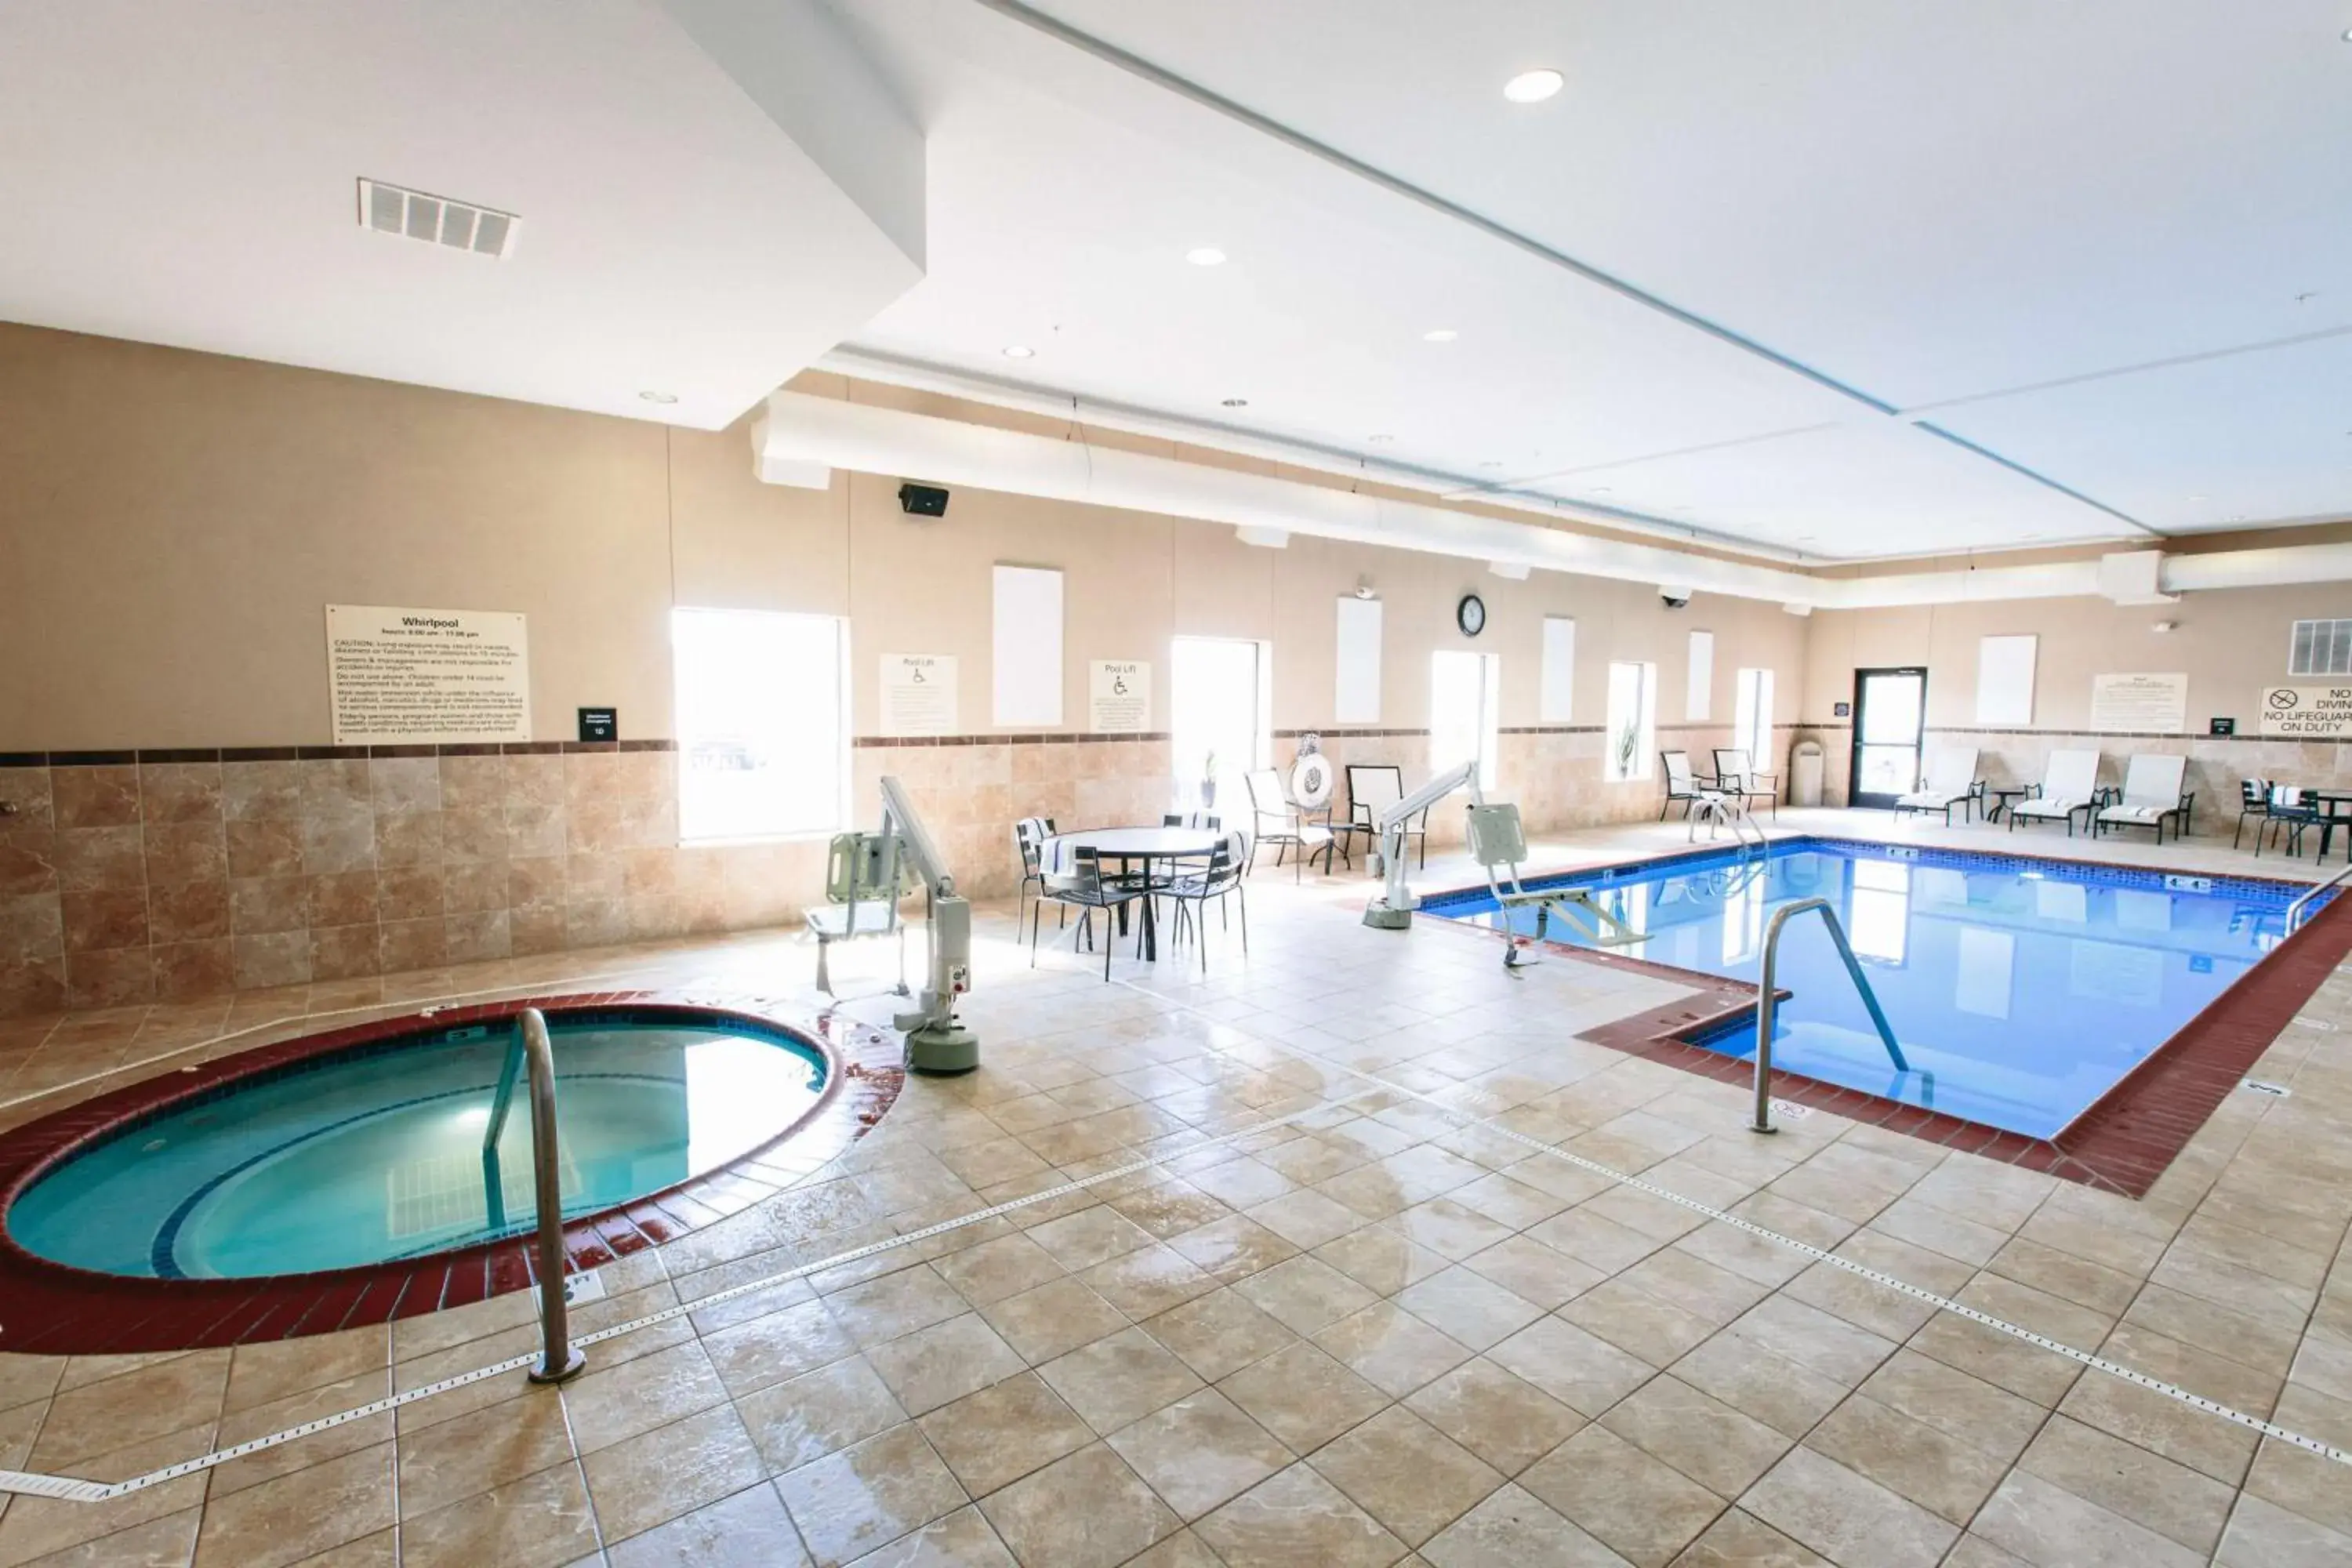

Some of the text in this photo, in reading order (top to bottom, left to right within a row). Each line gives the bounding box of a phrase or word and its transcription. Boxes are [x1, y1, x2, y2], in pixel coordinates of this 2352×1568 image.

[402, 616, 459, 629] Whirlpool
[1105, 663, 1121, 674] Pool
[2330, 689, 2351, 699] NO
[2317, 699, 2352, 709] DIVIN
[2264, 710, 2352, 722] NO LIFEGUAR
[2280, 722, 2343, 732] ON DUTY
